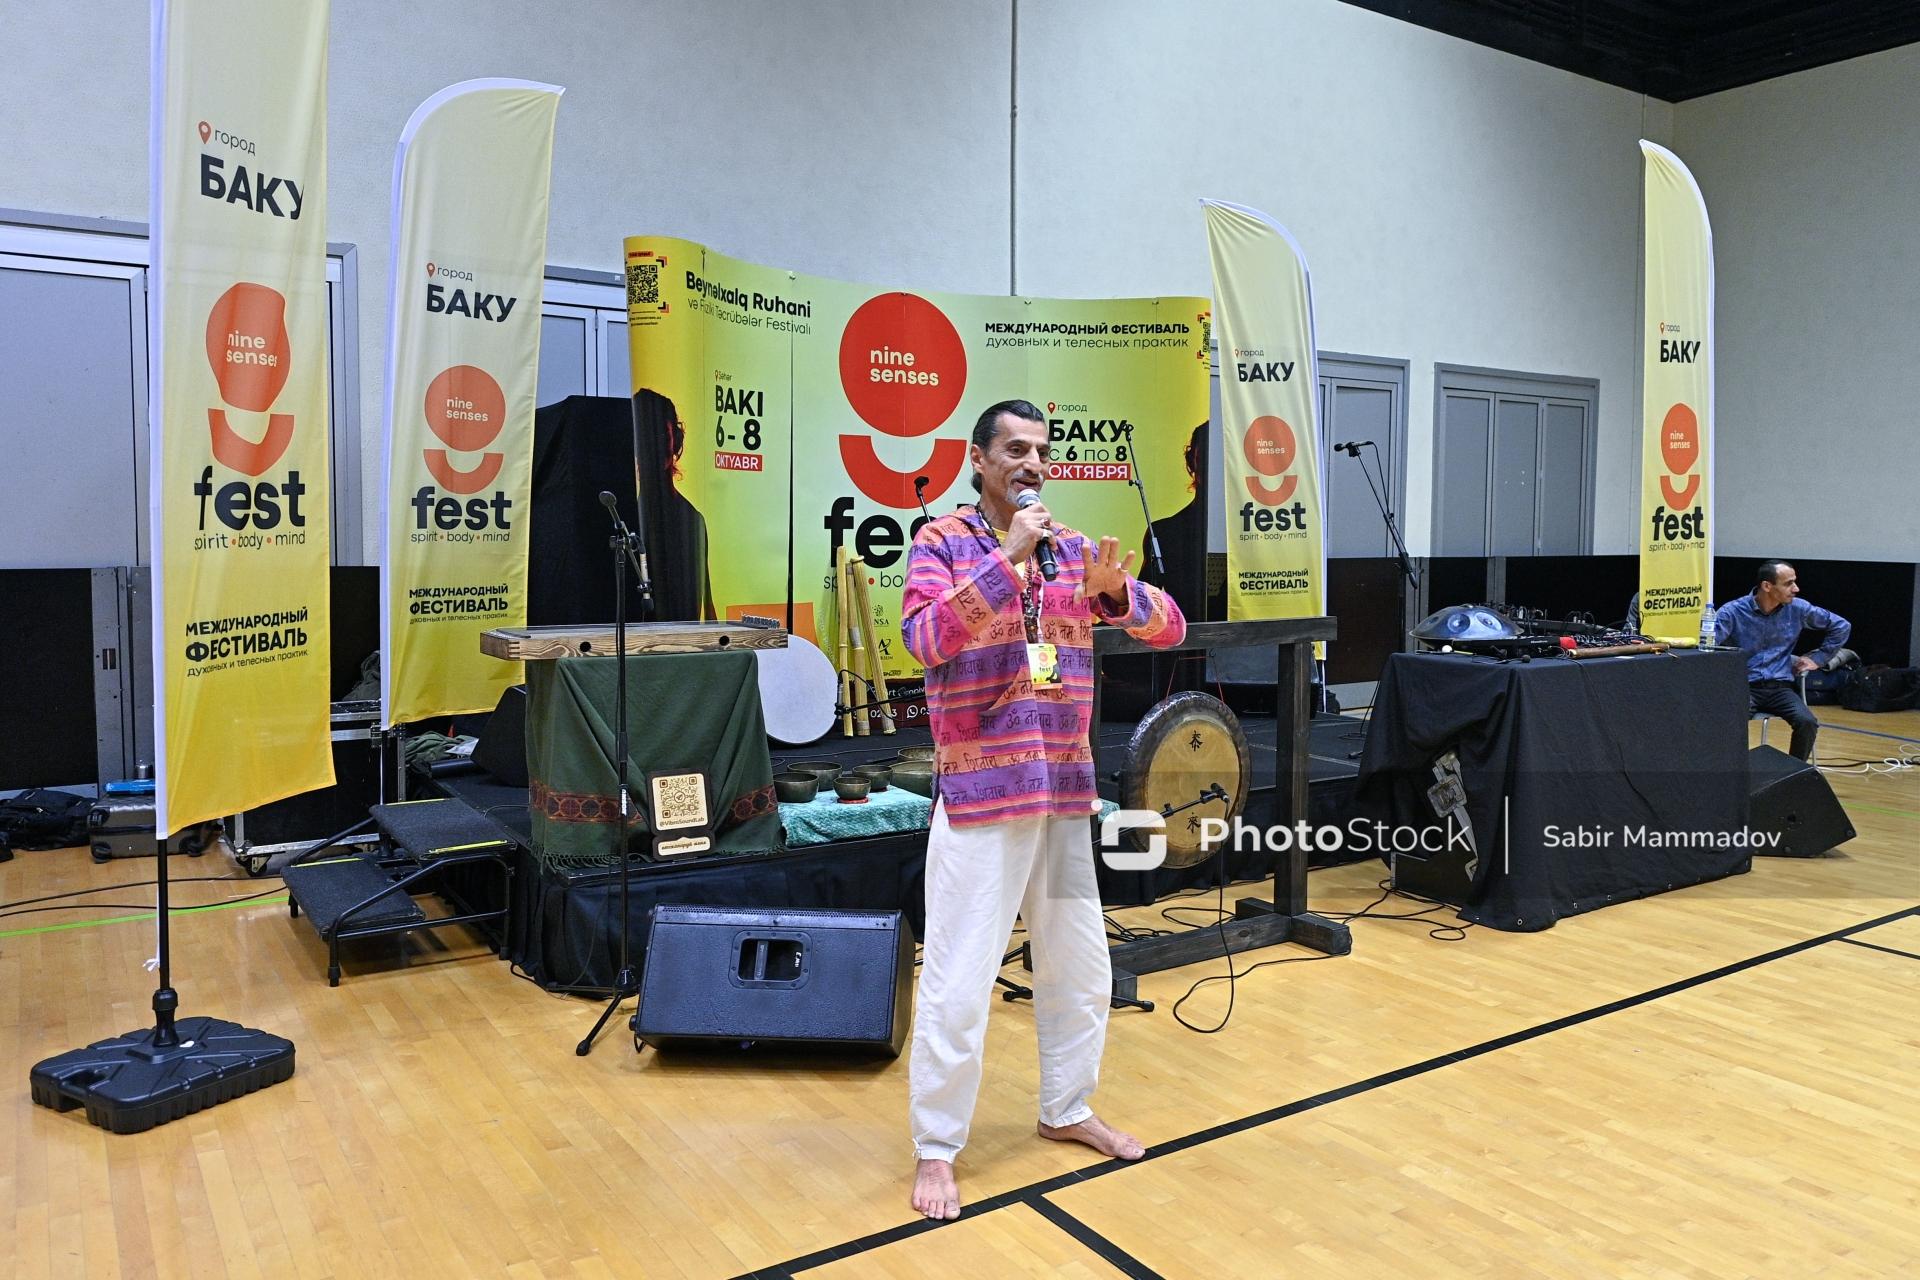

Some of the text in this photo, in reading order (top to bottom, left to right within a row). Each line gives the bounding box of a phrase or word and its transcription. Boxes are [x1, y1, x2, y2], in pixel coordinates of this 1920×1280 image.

[215, 128, 256, 156] город
[201, 153, 304, 220] БАКУ
[438, 266, 473, 281] город
[427, 284, 517, 322] БАКУ
[686, 271, 811, 318] Beynəlxalq Ruhani
[688, 298, 698, 310] və
[985, 322, 1190, 335] МЕЖДУНАРОДНЫЙ ФЕСТИВАЛЬ
[228, 330, 265, 349] nine
[986, 336, 1188, 349] духовных и телесных практик
[870, 346, 915, 366] nine
[1240, 349, 1264, 357] город
[1660, 339, 1701, 363] БАКУ
[870, 368, 939, 386] senses
[1238, 362, 1294, 382] БАКУ
[447, 398, 473, 409] nine
[716, 384, 763, 417] BAKI
[1057, 403, 1087, 413] город
[447, 409, 488, 422] senses
[1049, 419, 1127, 442] БАКУ
[1670, 430, 1684, 440] nine
[716, 454, 758, 470] OKTYABR
[1066, 446, 1078, 461] 6
[1115, 446, 1128, 461] 8
[1049, 465, 1128, 478] ОКТЯБРЯ
[194, 465, 305, 530] fest
[412, 486, 512, 530] fest
[1240, 502, 1306, 532] fest
[824, 497, 935, 568] fe
[1652, 506, 1705, 541] fest
[238, 532, 263, 550] body
[275, 530, 305, 546] mind
[411, 531, 510, 544] spirit body mind
[1240, 533, 1259, 541] spirit
[1264, 533, 1283, 541] body
[1239, 568, 1308, 579] МЕЖДУНАРОДНЫЙ
[410, 584, 508, 598] МЕЖДУНАРОДНЫЙ
[1240, 579, 1308, 590] ФЕСТИВАЛЬ
[410, 598, 508, 615] ФЕСТИВАЛЬ
[186, 606, 308, 636] МЕЖДУНАРОДНЫЙ
[186, 627, 307, 662] ФЕСТИВАЛЬ
